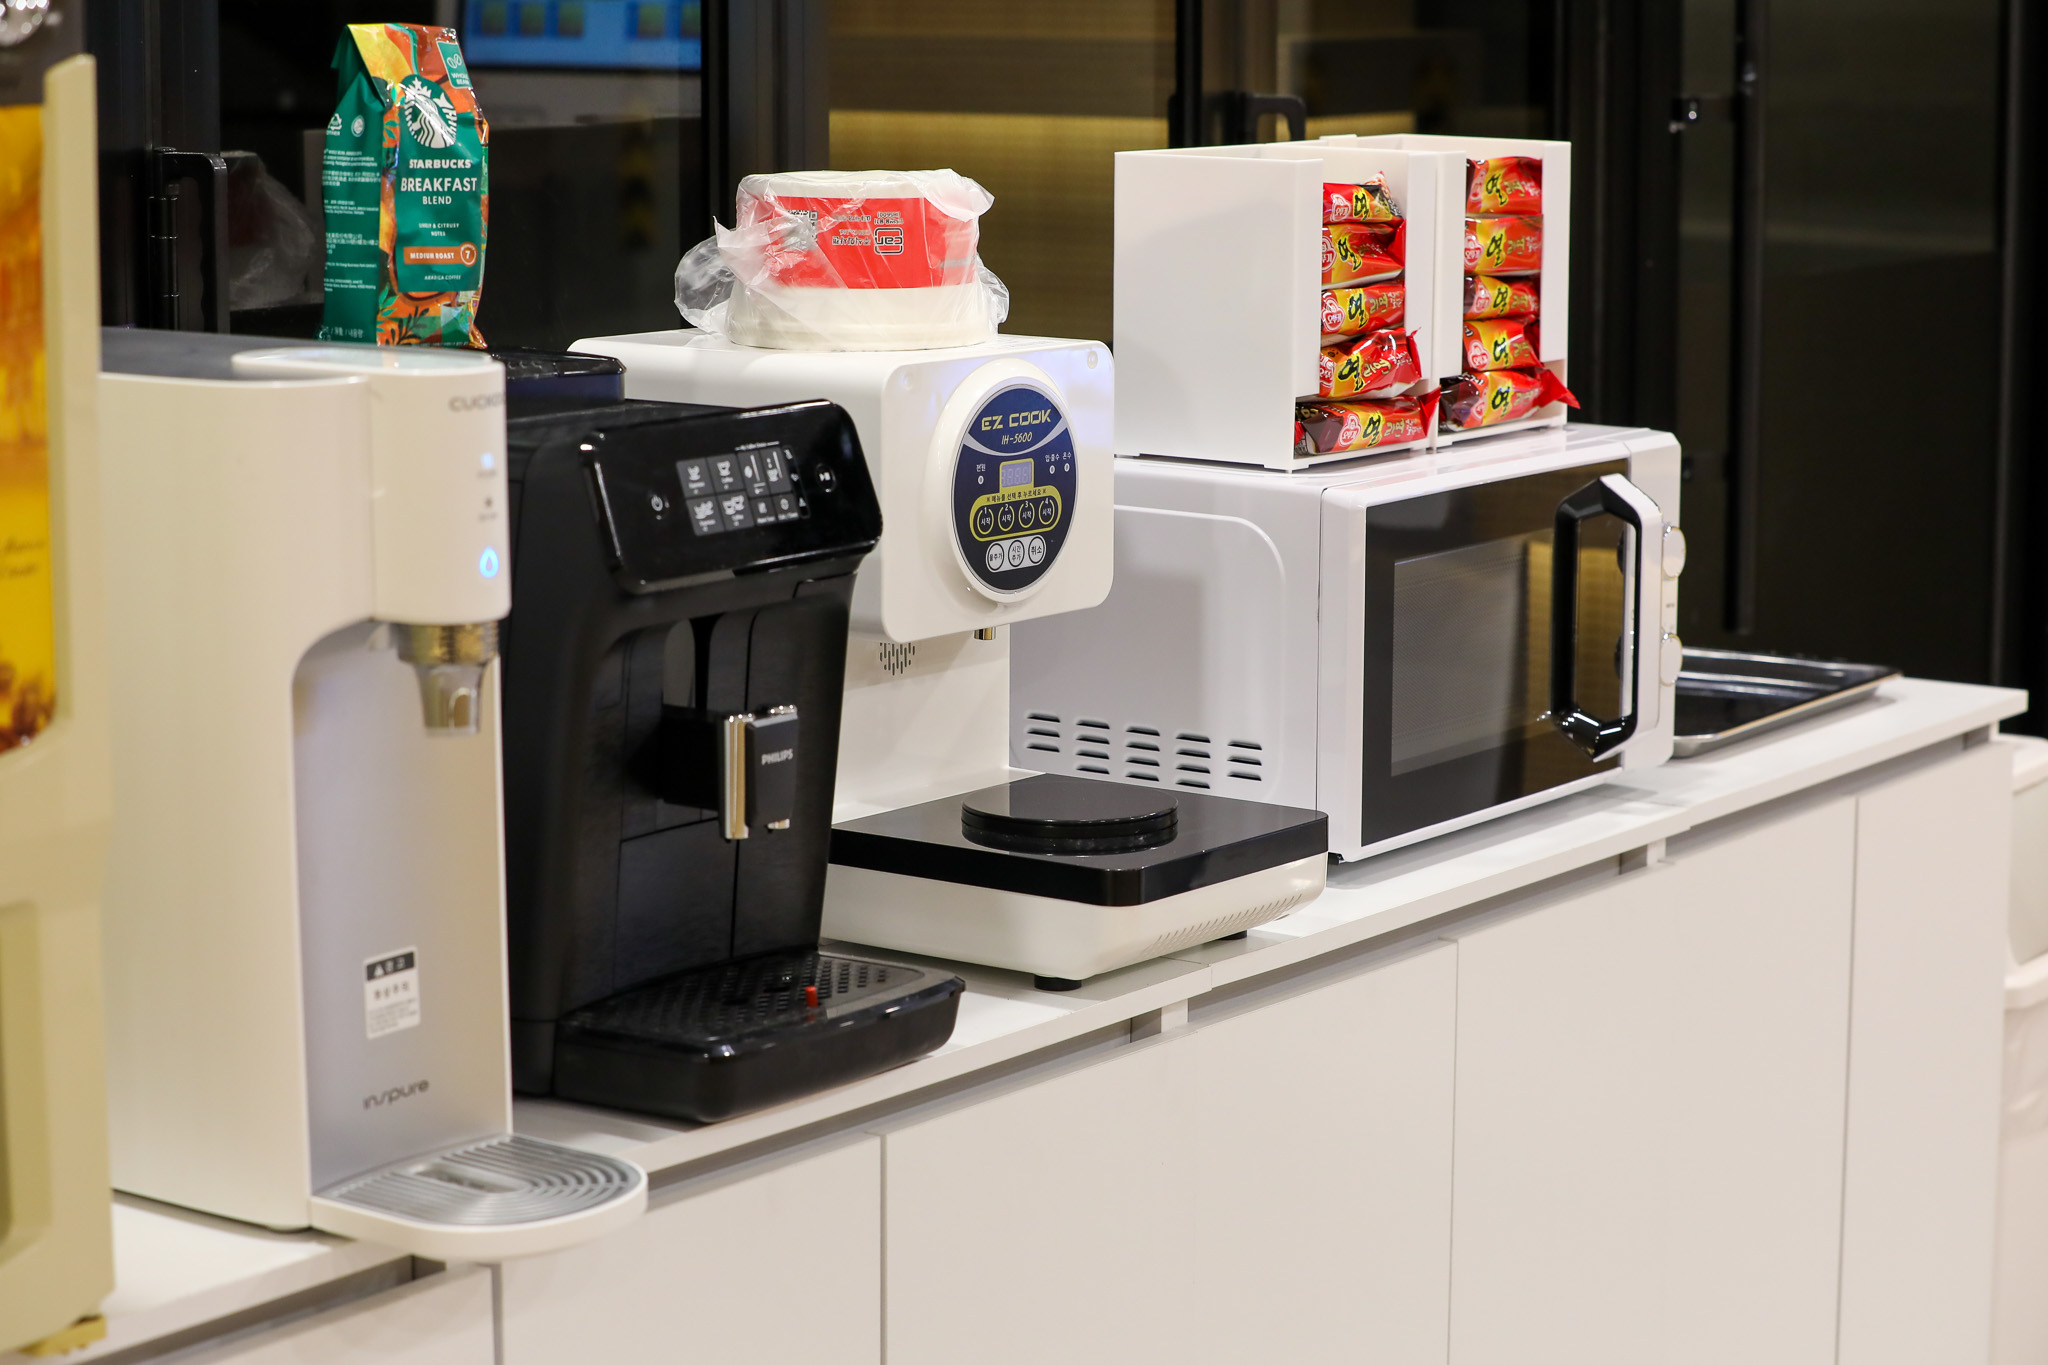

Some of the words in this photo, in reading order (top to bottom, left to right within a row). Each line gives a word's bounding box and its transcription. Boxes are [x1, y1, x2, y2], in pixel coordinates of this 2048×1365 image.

[409, 159, 472, 169] STARBUCKS
[400, 177, 477, 192] BREAKFAST
[422, 195, 452, 205] BLEND
[465, 250, 471, 259] 7
[981, 415, 1004, 431] EZ
[1009, 409, 1051, 427] COOK
[1001, 432, 1033, 445] IH-5600
[976, 463, 986, 472] 전원
[991, 494, 1006, 502] 메뉴를
[1007, 492, 1016, 500] 선택
[1023, 488, 1042, 498] 누르세요
[1022, 510, 1032, 519] 시작
[1042, 507, 1052, 516] 시작
[981, 517, 991, 526] 시작
[1002, 514, 1012, 523] 시작
[1012, 545, 1021, 553] 시간
[1031, 545, 1042, 555] 취소
[1012, 554, 1021, 562] 추가
[761, 748, 794, 766] PHILIPS
